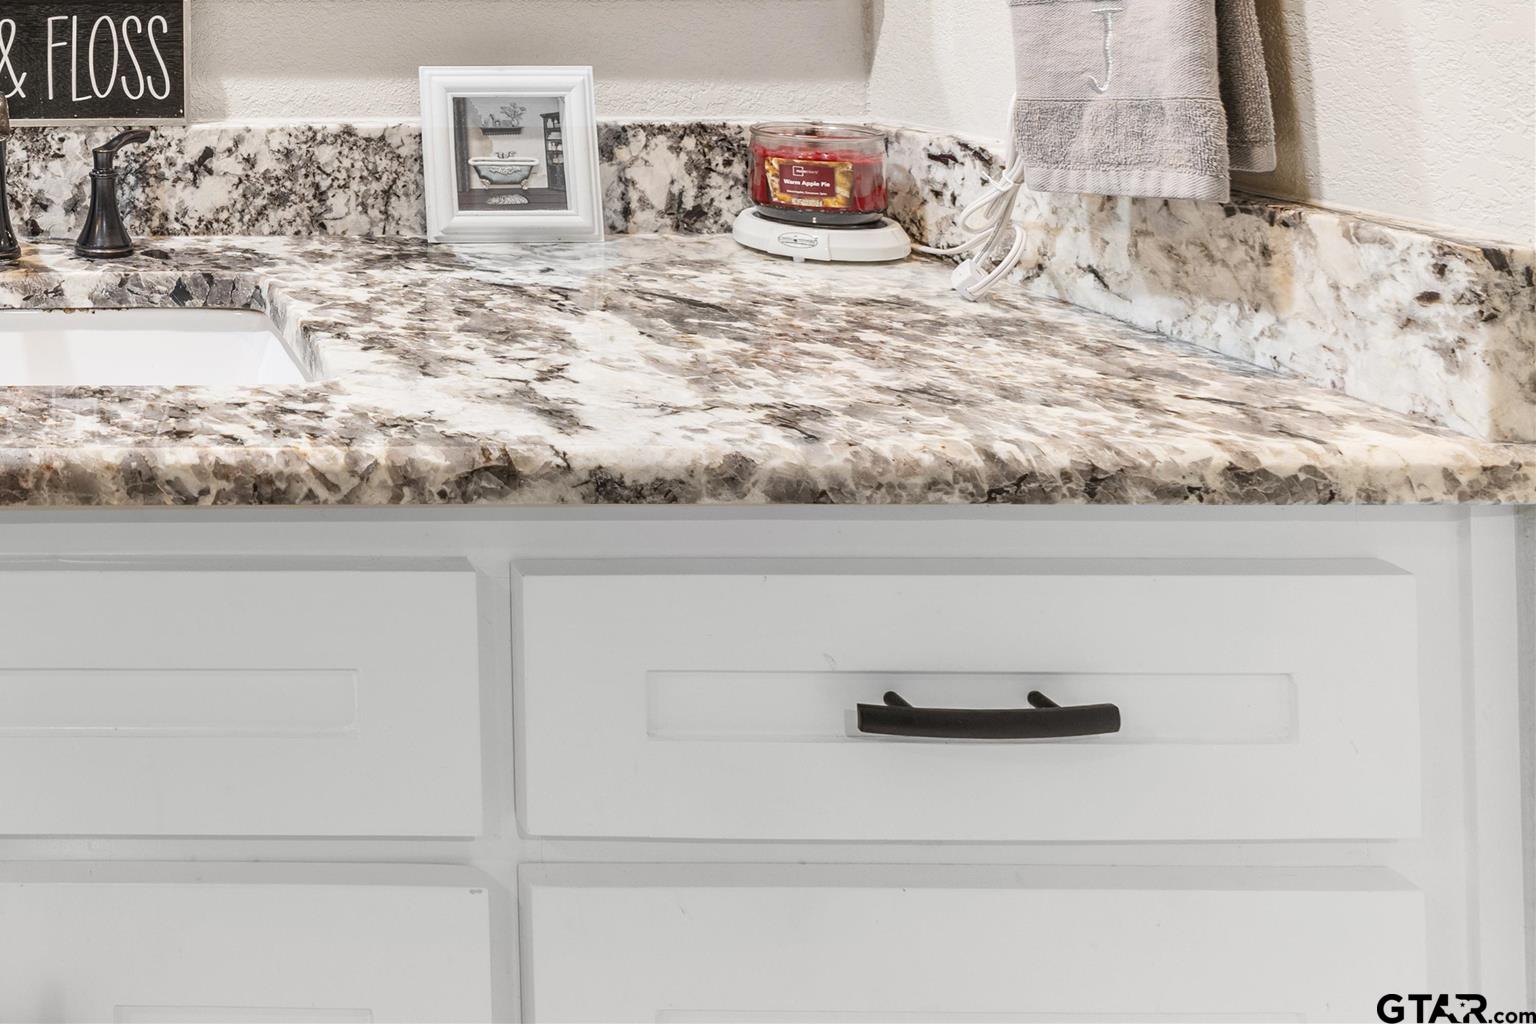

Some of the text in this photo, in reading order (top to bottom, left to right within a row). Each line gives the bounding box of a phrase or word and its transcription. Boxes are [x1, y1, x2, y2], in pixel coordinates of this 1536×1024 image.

[47, 15, 171, 102] FLOSS
[1086, 7, 1124, 94] J
[783, 178, 801, 186] Warm
[802, 179, 820, 189] Apple
